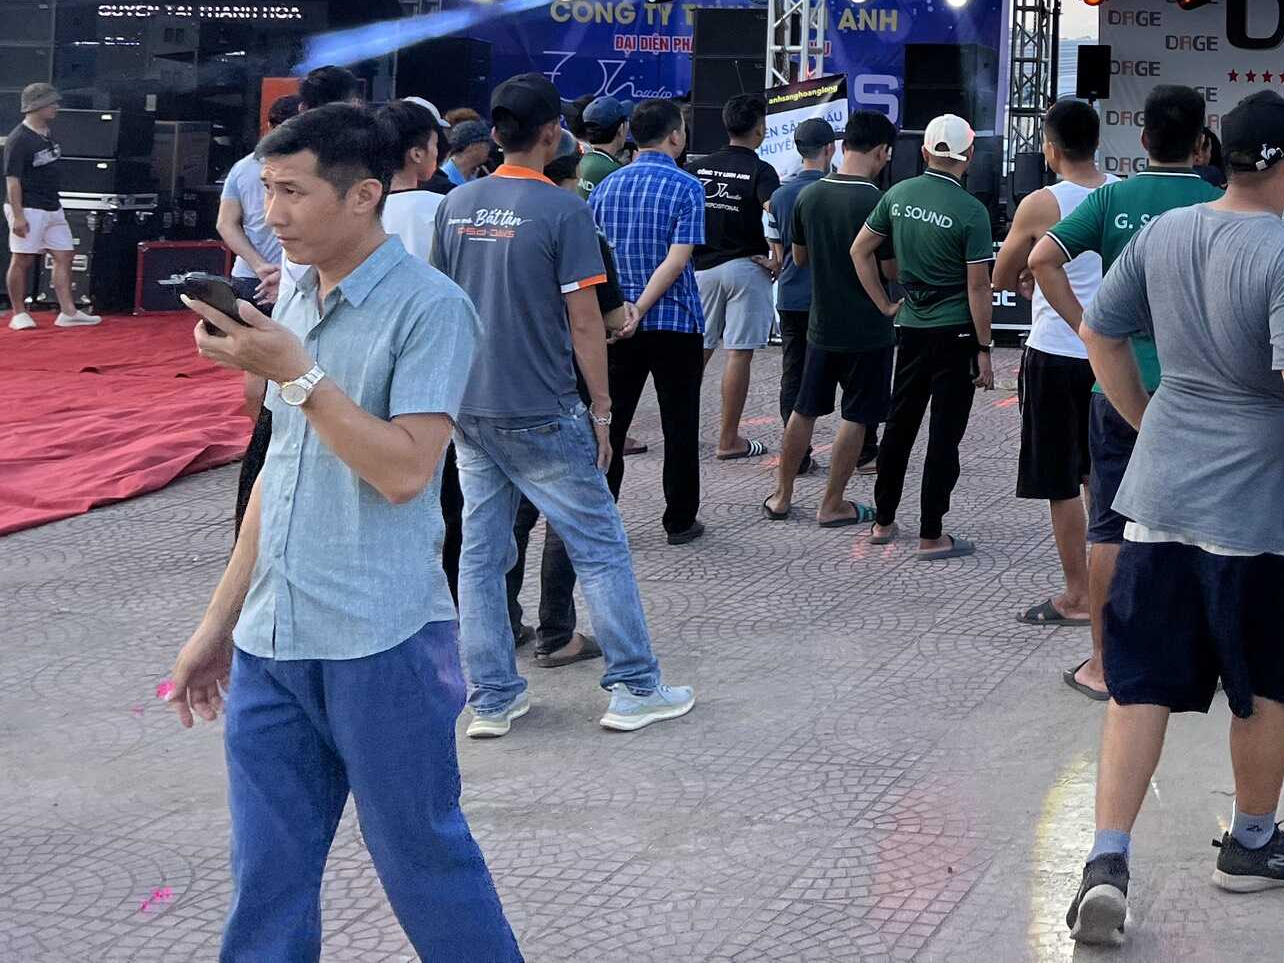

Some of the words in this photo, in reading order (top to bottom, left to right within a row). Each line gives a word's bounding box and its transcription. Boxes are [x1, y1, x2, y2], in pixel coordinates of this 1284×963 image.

[643, 3, 673, 26] TY
[837, 8, 899, 32] ANH
[1107, 10, 1162, 27] DAGE
[1165, 35, 1219, 52] DAGE
[1110, 60, 1161, 77] DAGE
[768, 84, 839, 105] anhsanghoanglong
[891, 203, 901, 217] G.
[904, 205, 953, 229] SOUND
[1114, 213, 1134, 230] G.
